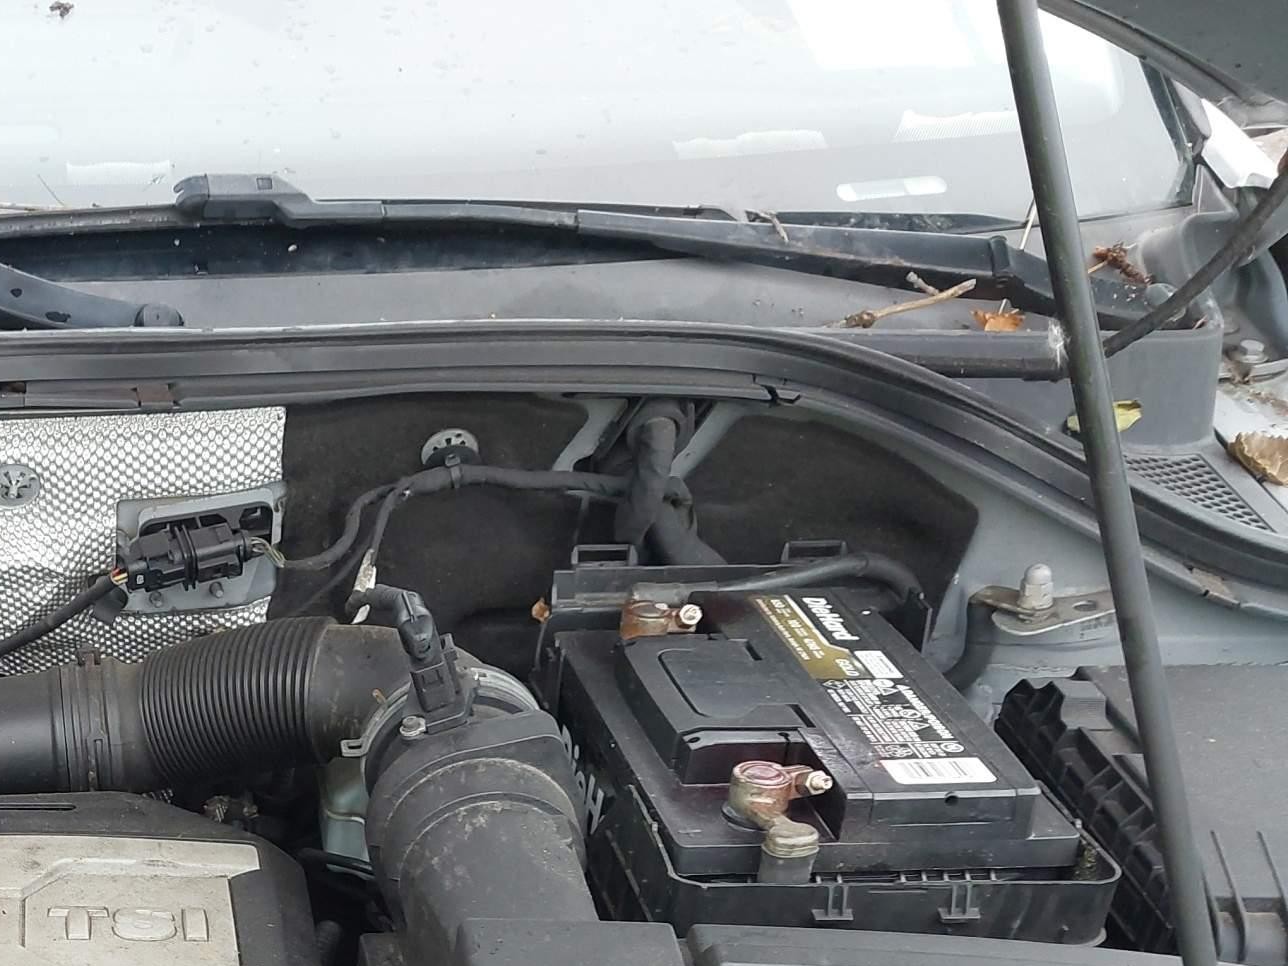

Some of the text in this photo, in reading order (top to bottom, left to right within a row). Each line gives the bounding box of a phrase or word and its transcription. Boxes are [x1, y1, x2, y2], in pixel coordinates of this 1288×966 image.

[802, 597, 860, 640] DieHard
[835, 659, 860, 677] GOLD
[47, 905, 210, 943] TSI
